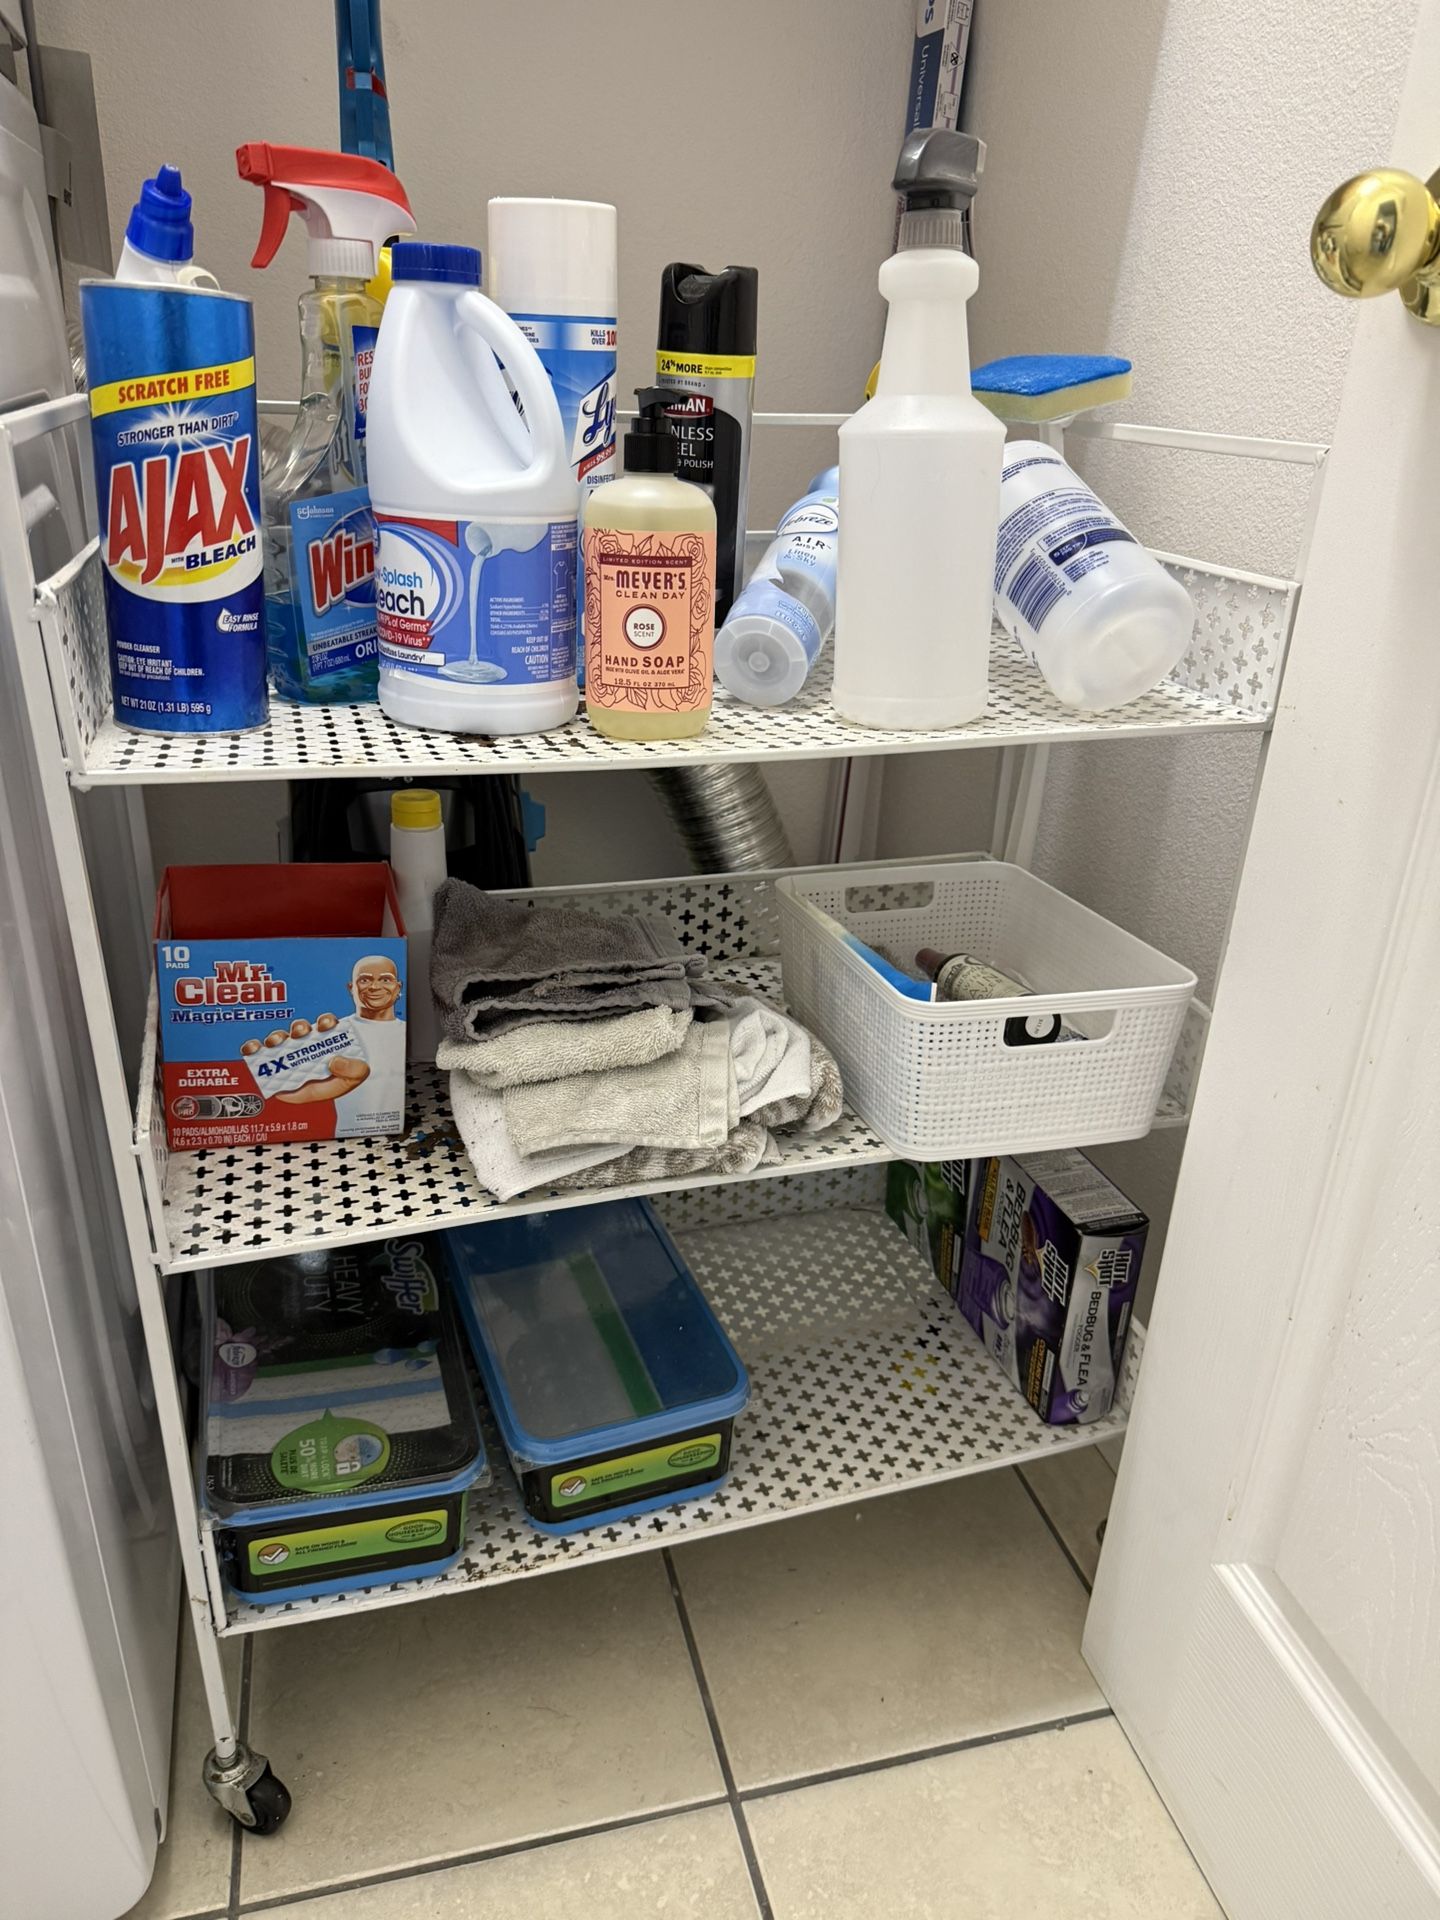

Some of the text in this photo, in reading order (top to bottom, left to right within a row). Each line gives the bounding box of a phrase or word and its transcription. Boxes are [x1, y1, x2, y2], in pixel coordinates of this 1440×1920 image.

[913, 44, 930, 127] Universal
[591, 329, 605, 337] KILLS
[592, 337, 605, 345] OVER
[676, 363, 703, 374] MORE
[118, 369, 230, 404] SCRATCH FREE
[117, 425, 175, 446] STRONGER
[178, 419, 208, 436] THAN
[683, 459, 714, 469] POLISH
[107, 437, 256, 586] AJAX
[185, 535, 256, 570] BLEACH
[788, 548, 817, 561] Linen
[616, 569, 687, 590] MEYER'S
[616, 590, 685, 600] CLEAN DAY
[223, 613, 242, 625] EASY
[228, 622, 257, 633] FORMULA
[133, 643, 160, 654] CLEANSER
[312, 634, 353, 652] UNBEATABLE
[355, 639, 378, 658] ORI
[136, 656, 146, 665] EYE
[525, 654, 549, 665] CAUTION
[605, 654, 685, 668] HAND SOAP
[128, 663, 137, 672] OUT
[137, 665, 144, 673] OF
[145, 666, 163, 675] REACH
[164, 667, 172, 676] OF
[614, 678, 631, 686] 12.5
[130, 697, 139, 708] WT
[140, 700, 147, 709] 21
[147, 700, 157, 711] OZ
[157, 701, 175, 713] (1.31
[176, 702, 189, 714] LB)
[190, 702, 205, 712] 595
[205, 705, 211, 715] g
[162, 946, 190, 962] 10
[214, 960, 271, 983] Mr.
[175, 976, 287, 1007] Clean
[171, 1007, 295, 1024] MagicEraser
[257, 1056, 290, 1077] 4X
[290, 1056, 311, 1068] WITH
[187, 1068, 230, 1078] EXTRA
[178, 1077, 239, 1087] DURABLE
[173, 1127, 181, 1137] 10
[181, 1124, 249, 1136] PADS/ALMOHADILLAS
[250, 1123, 264, 1133] 11.7
[270, 1123, 281, 1131] 5.9
[287, 1122, 297, 1130] 1.8
[298, 1122, 308, 1130] cm
[172, 1136, 186, 1147] (4.6
[191, 1136, 201, 1145] 2.3
[208, 1135, 222, 1144] 0.70
[233, 1134, 251, 1143] EACH
[998, 1178, 1014, 1249] & FLEA
[1006, 1182, 1026, 1272] BEDBUG
[1041, 1239, 1058, 1301] SHOT
[1099, 1249, 1115, 1288] SHOT
[1114, 1249, 1132, 1283] HOT
[333, 1255, 364, 1314] HEAVY
[382, 1238, 429, 1316] Swiffer
[1053, 1255, 1069, 1307] HOT
[1077, 1291, 1102, 1386] BEDBUG & FLEA
